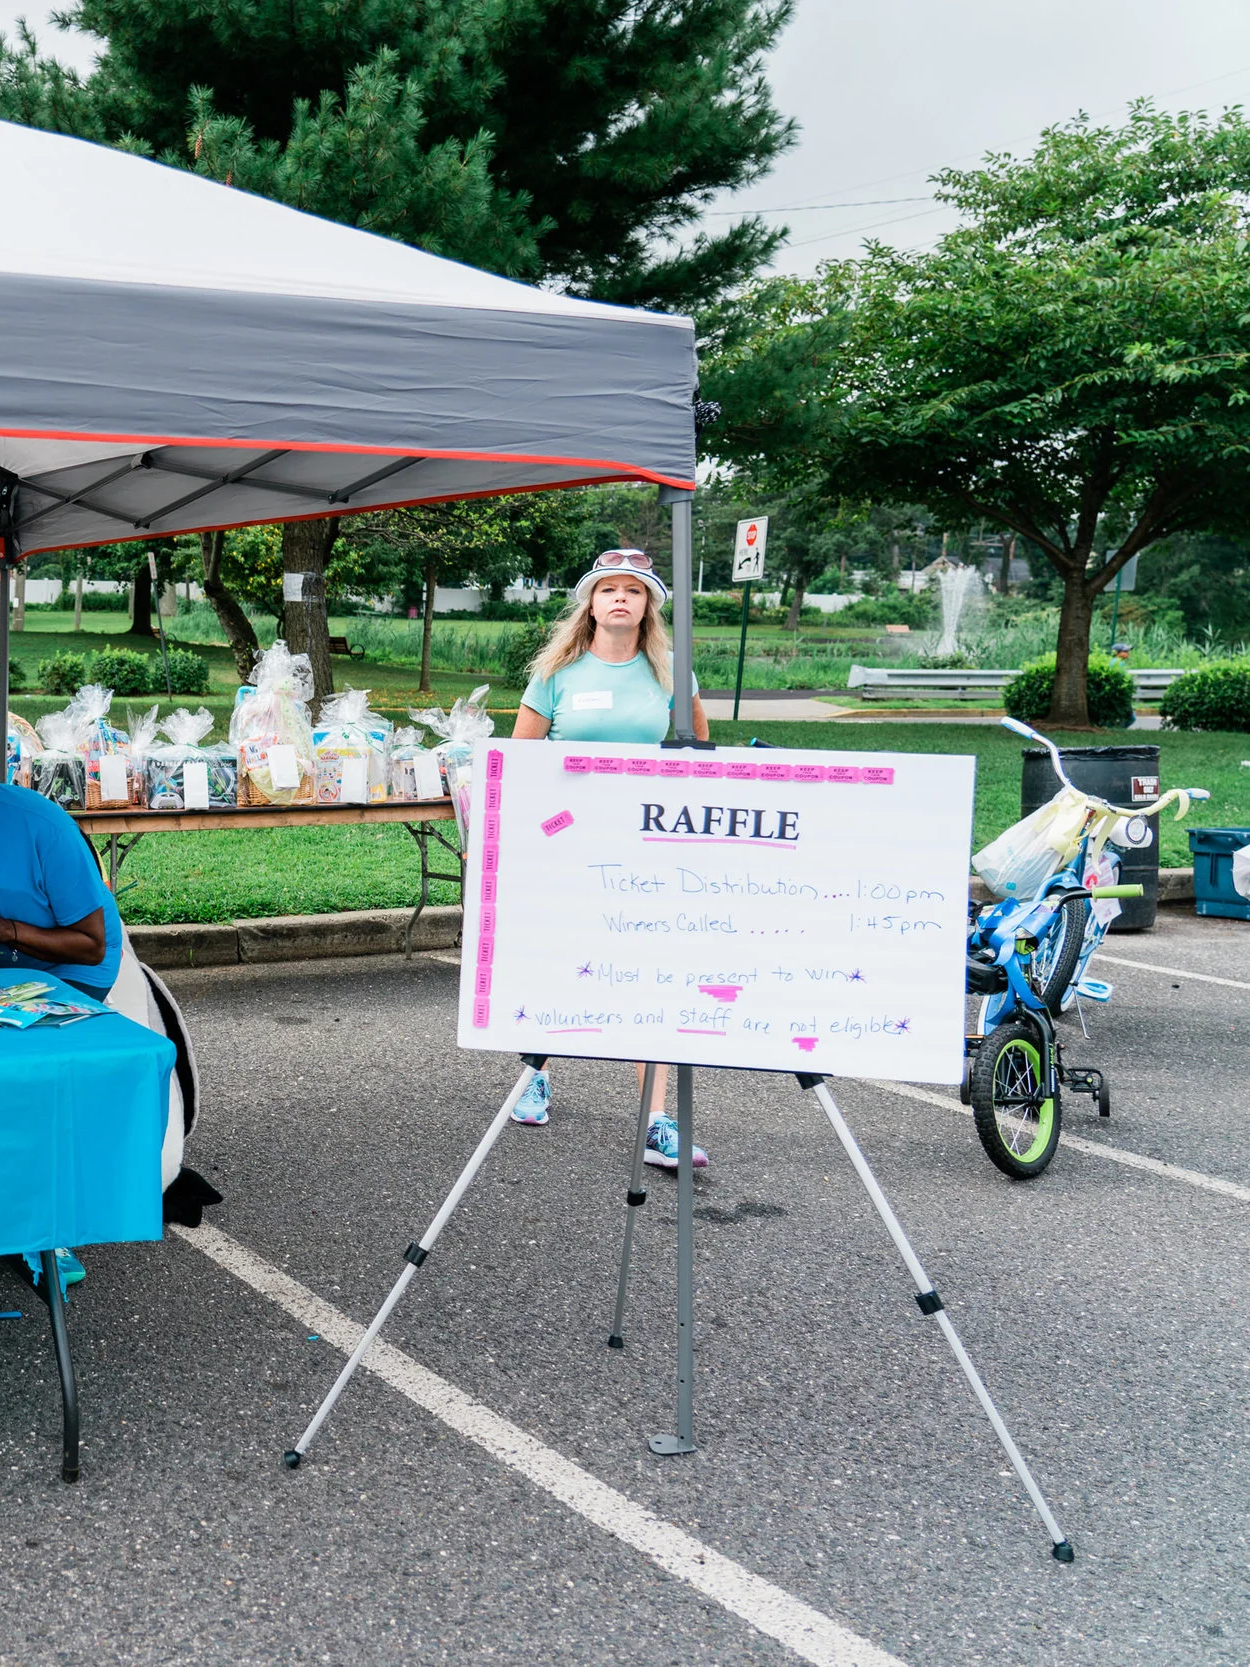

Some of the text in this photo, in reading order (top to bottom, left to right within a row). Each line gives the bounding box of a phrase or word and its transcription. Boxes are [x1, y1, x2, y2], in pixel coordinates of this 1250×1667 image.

[490, 758, 499, 777] TICKET
[488, 788, 497, 808] TICKET
[487, 819, 495, 839] TICKET
[545, 816, 566, 832] TICKET
[639, 803, 800, 841] RAFFLE
[485, 850, 494, 870] TICKET
[587, 864, 666, 893] Ticket
[484, 881, 492, 901] TICKET
[483, 911, 491, 931] TICKET
[602, 910, 671, 933] Winners
[480, 942, 489, 962] TICKET
[478, 973, 487, 993] TICKET
[656, 967, 674, 984] be
[686, 967, 758, 987] present
[771, 966, 794, 982] to
[477, 1004, 485, 1024] TICKET
[633, 1008, 664, 1025] and
[743, 1017, 771, 1034] are
[789, 1015, 817, 1033] not
